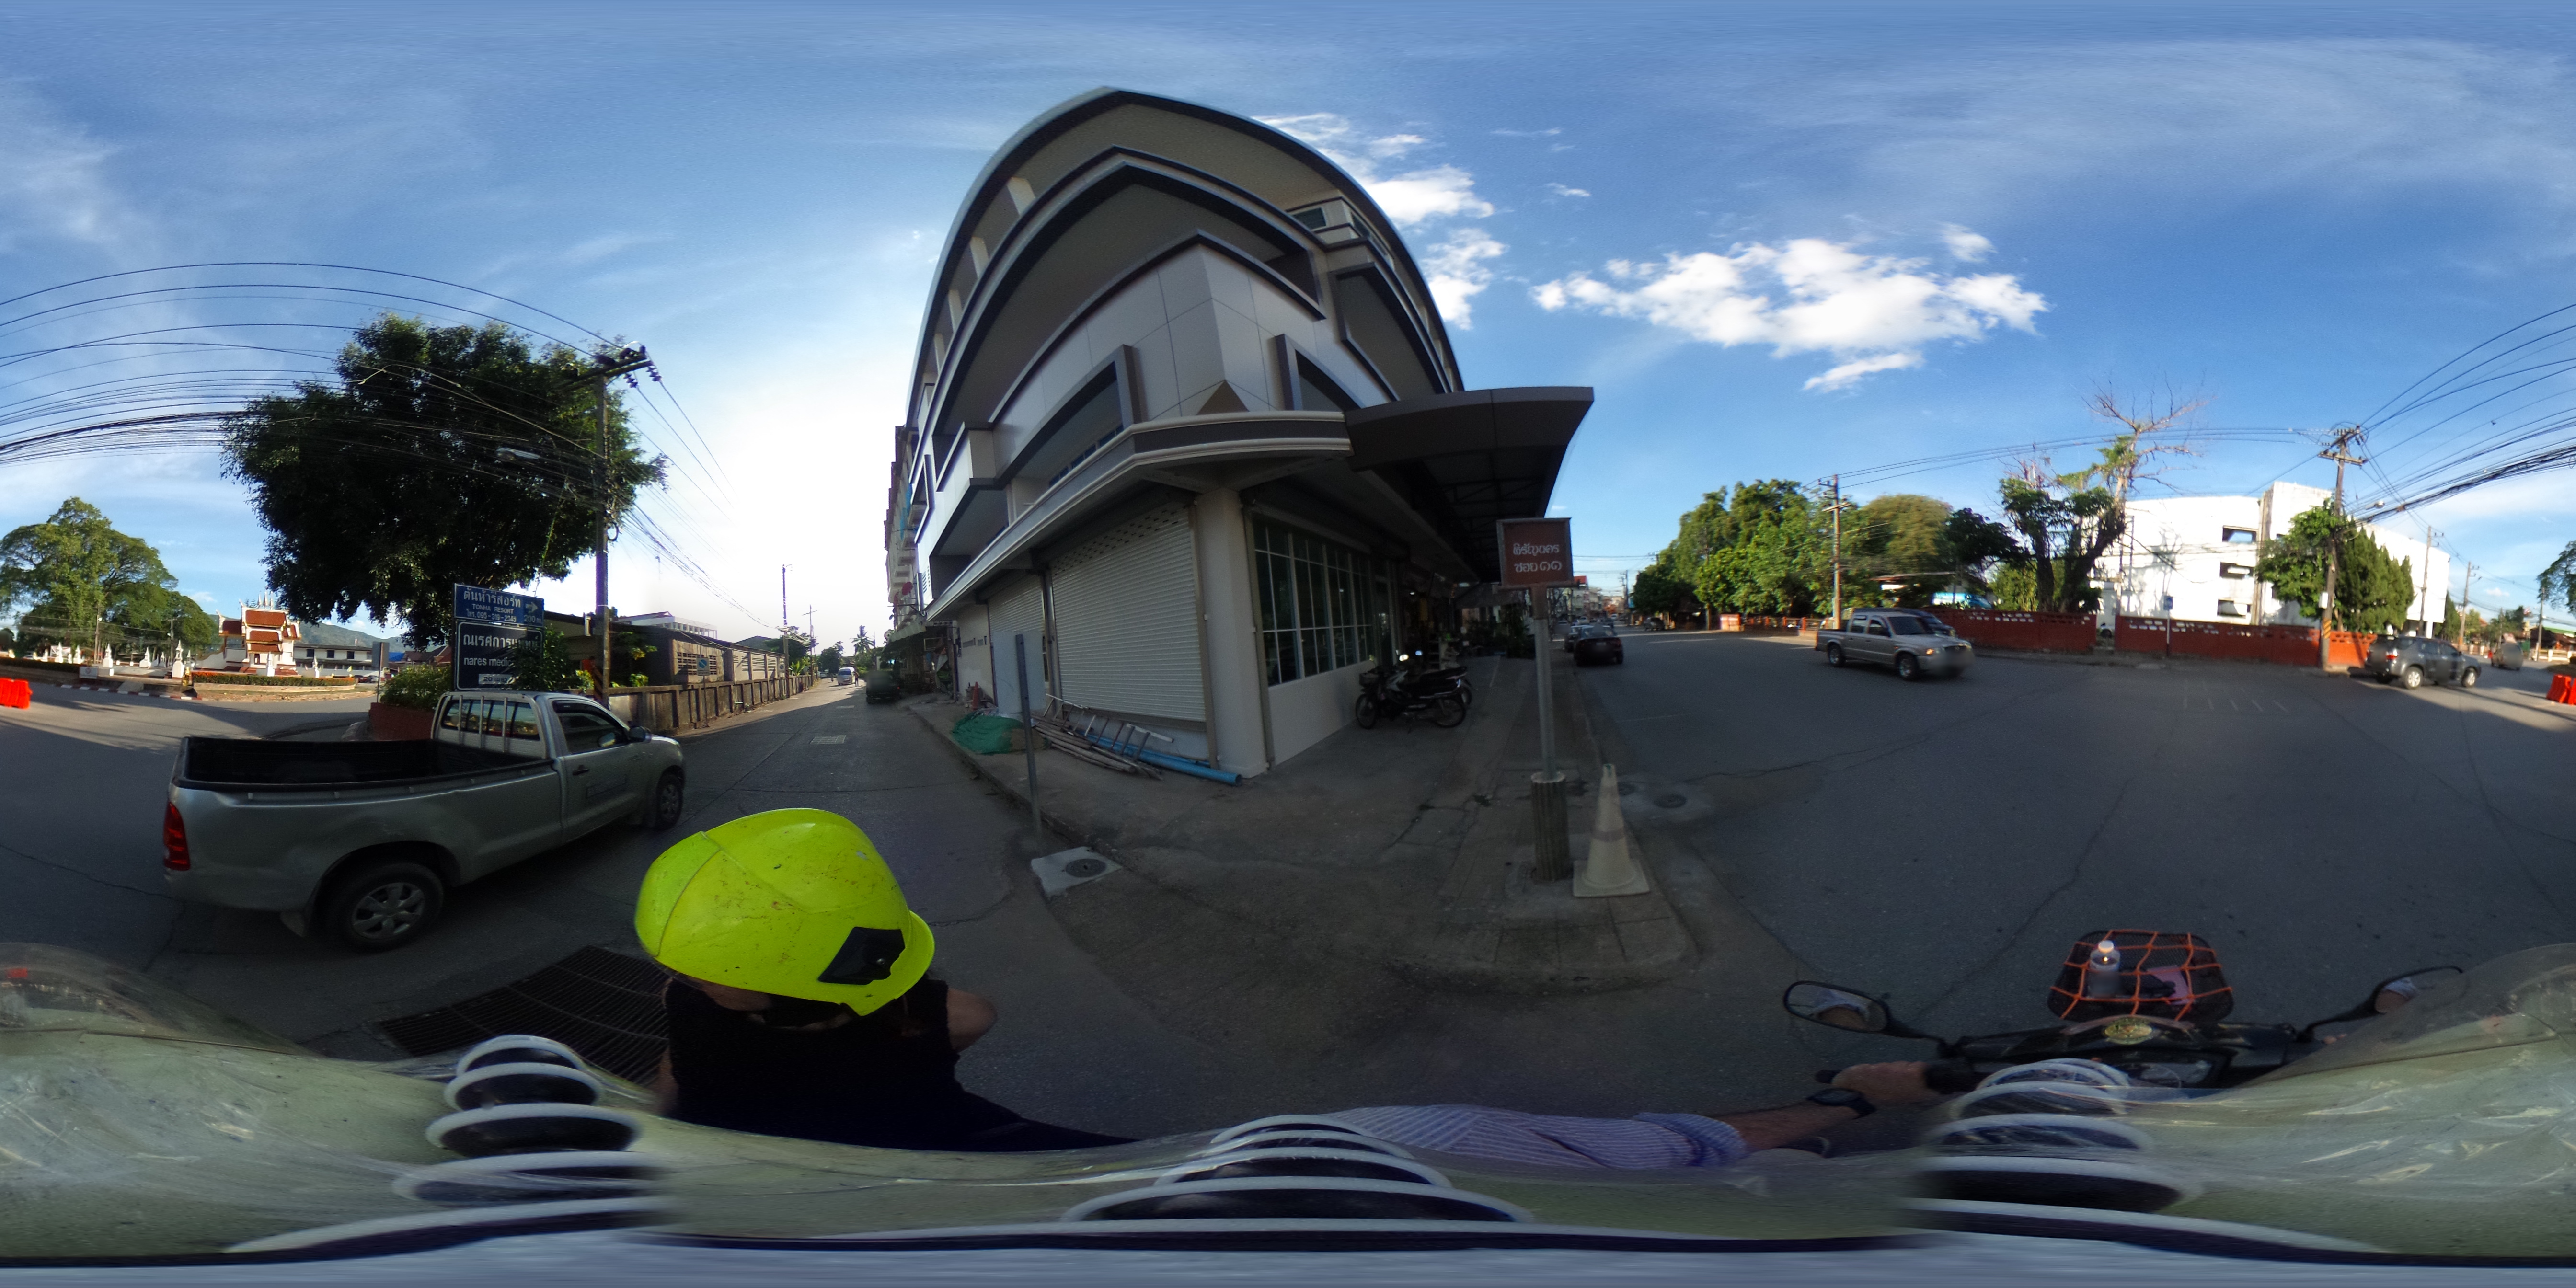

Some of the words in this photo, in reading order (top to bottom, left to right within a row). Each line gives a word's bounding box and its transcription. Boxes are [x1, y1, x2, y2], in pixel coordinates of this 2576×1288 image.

[1513, 543, 1560, 556] หิรัญนคร
[1514, 563, 1538, 573] ซอย
[1539, 561, 1562, 571] ๑๑
[463, 587, 521, 608] ต้นห้ารีสอร์ท
[524, 614, 536, 622] 200
[464, 657, 487, 666] nares
